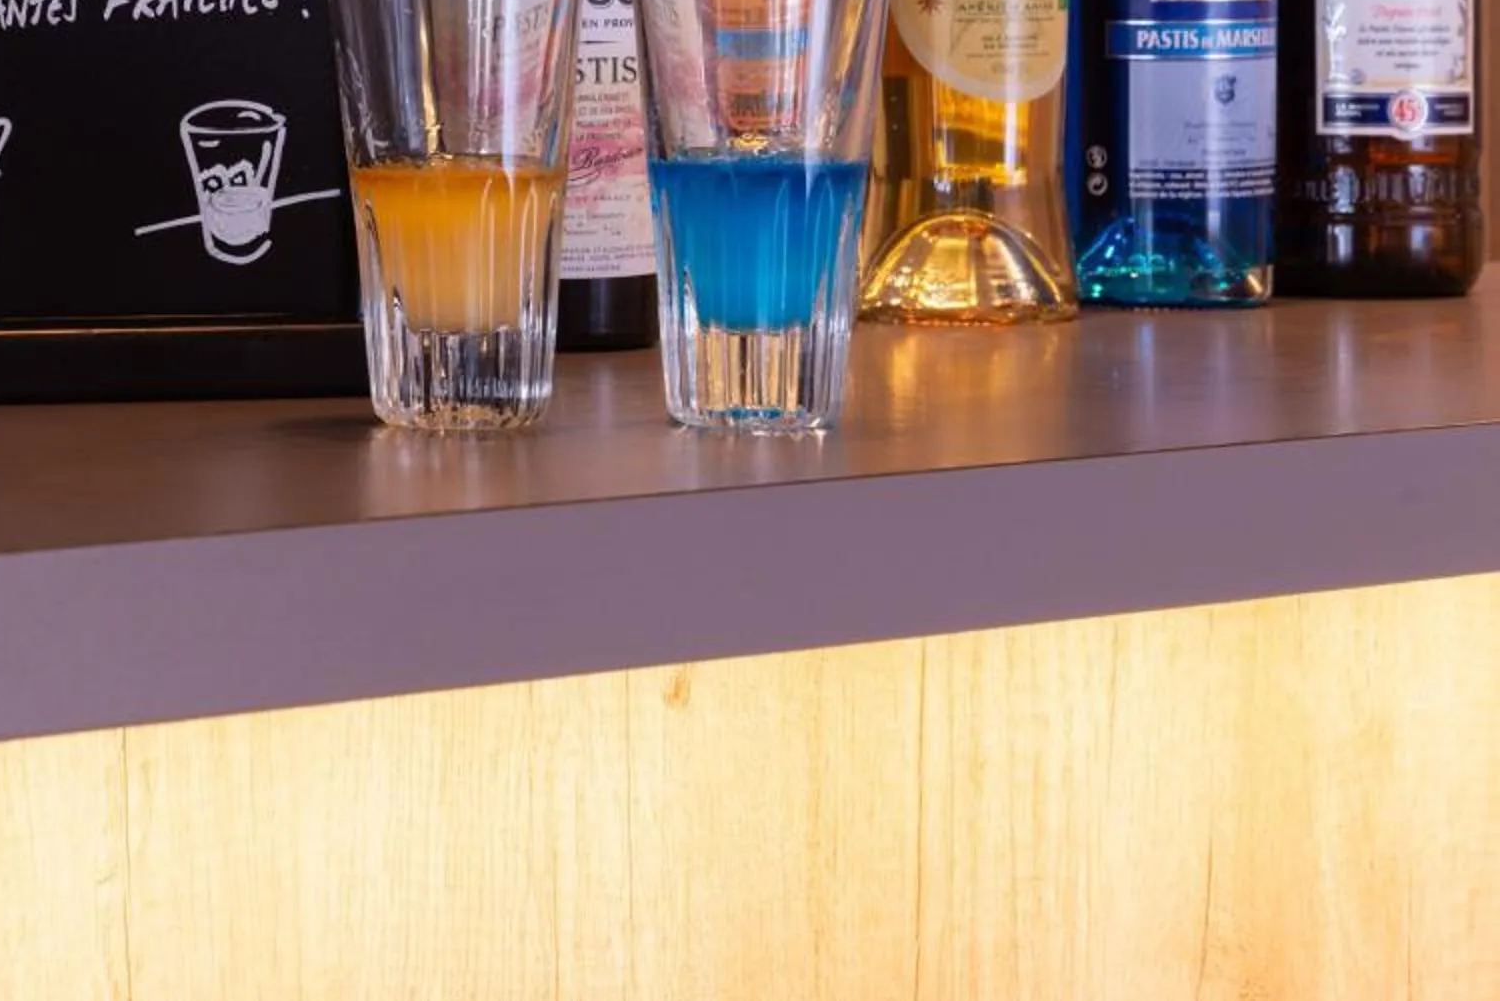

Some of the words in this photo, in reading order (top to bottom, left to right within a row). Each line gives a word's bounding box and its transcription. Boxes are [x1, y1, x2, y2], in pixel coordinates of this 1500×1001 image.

[1136, 29, 1199, 49] PASTIS
[576, 56, 637, 85] STIS
[1394, 99, 1416, 121] 45
